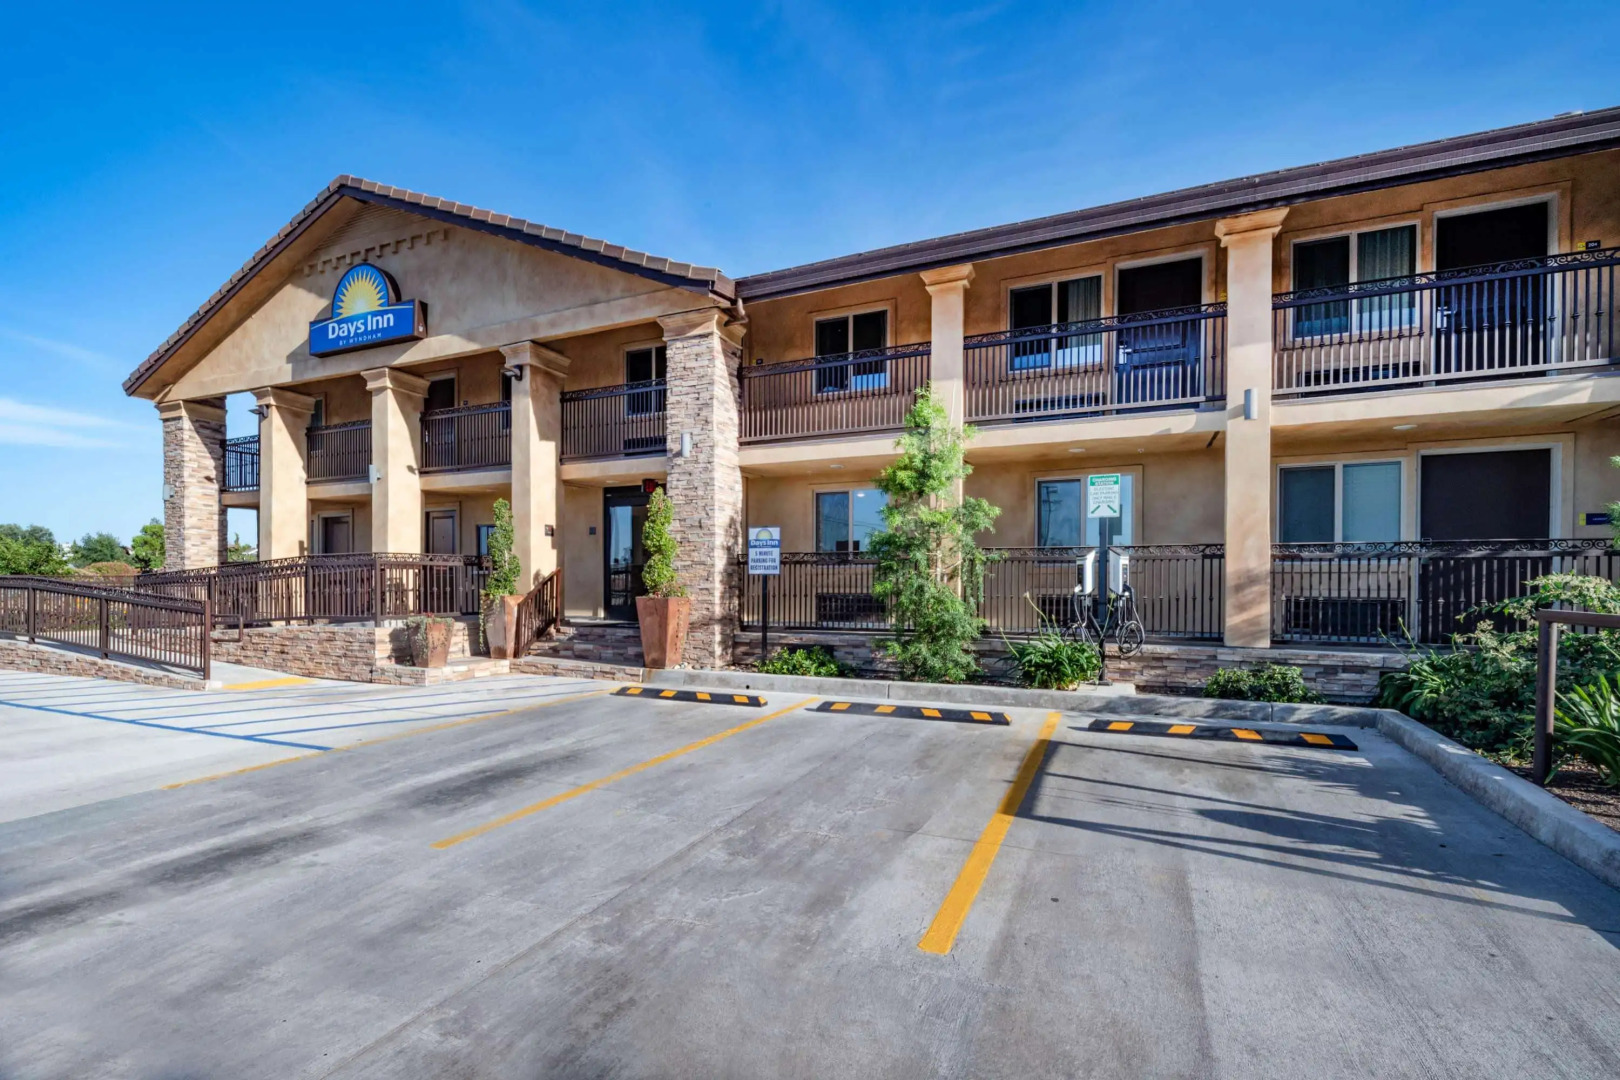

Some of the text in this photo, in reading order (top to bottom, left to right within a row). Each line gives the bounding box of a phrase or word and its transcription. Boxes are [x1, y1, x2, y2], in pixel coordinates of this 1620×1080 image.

[328, 313, 394, 339] Days Inn
[349, 333, 382, 344] WYNDHAM
